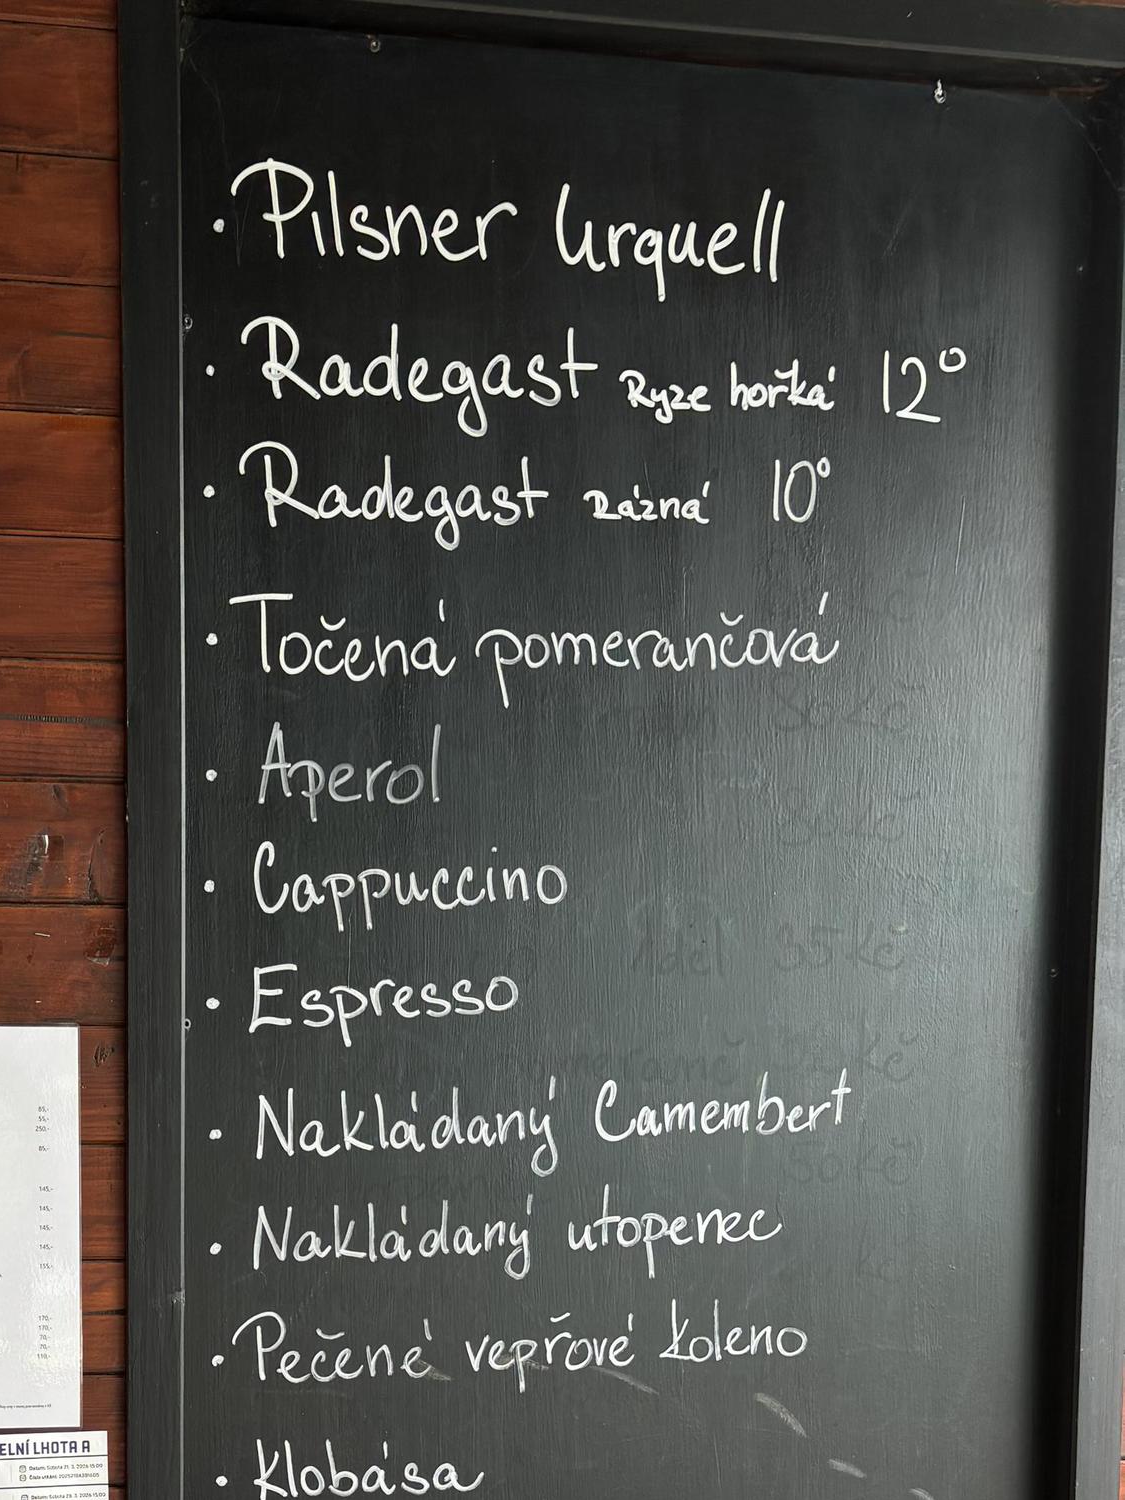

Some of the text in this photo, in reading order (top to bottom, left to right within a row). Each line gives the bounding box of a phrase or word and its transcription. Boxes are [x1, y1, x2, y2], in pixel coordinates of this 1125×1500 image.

[230, 158, 785, 302] Pilsner Urquell
[240, 316, 598, 437] Radegast
[619, 370, 711, 424] Ryze
[730, 359, 835, 411] hořká
[238, 441, 548, 551] Radegast
[229, 591, 840, 708] Točená pomerančová
[258, 721, 442, 822] Aperol
[254, 841, 568, 932] Cappuccino
[249, 963, 519, 1047] Espresso
[255, 1069, 851, 1176] Nakládaný Camembert
[253, 1185, 783, 1279] Nakládaný utopenec
[232, 1300, 808, 1392] Pečené vepřové koleno
[34, 1441, 77, 1455] LHOTA
[81, 1440, 90, 1452] A
